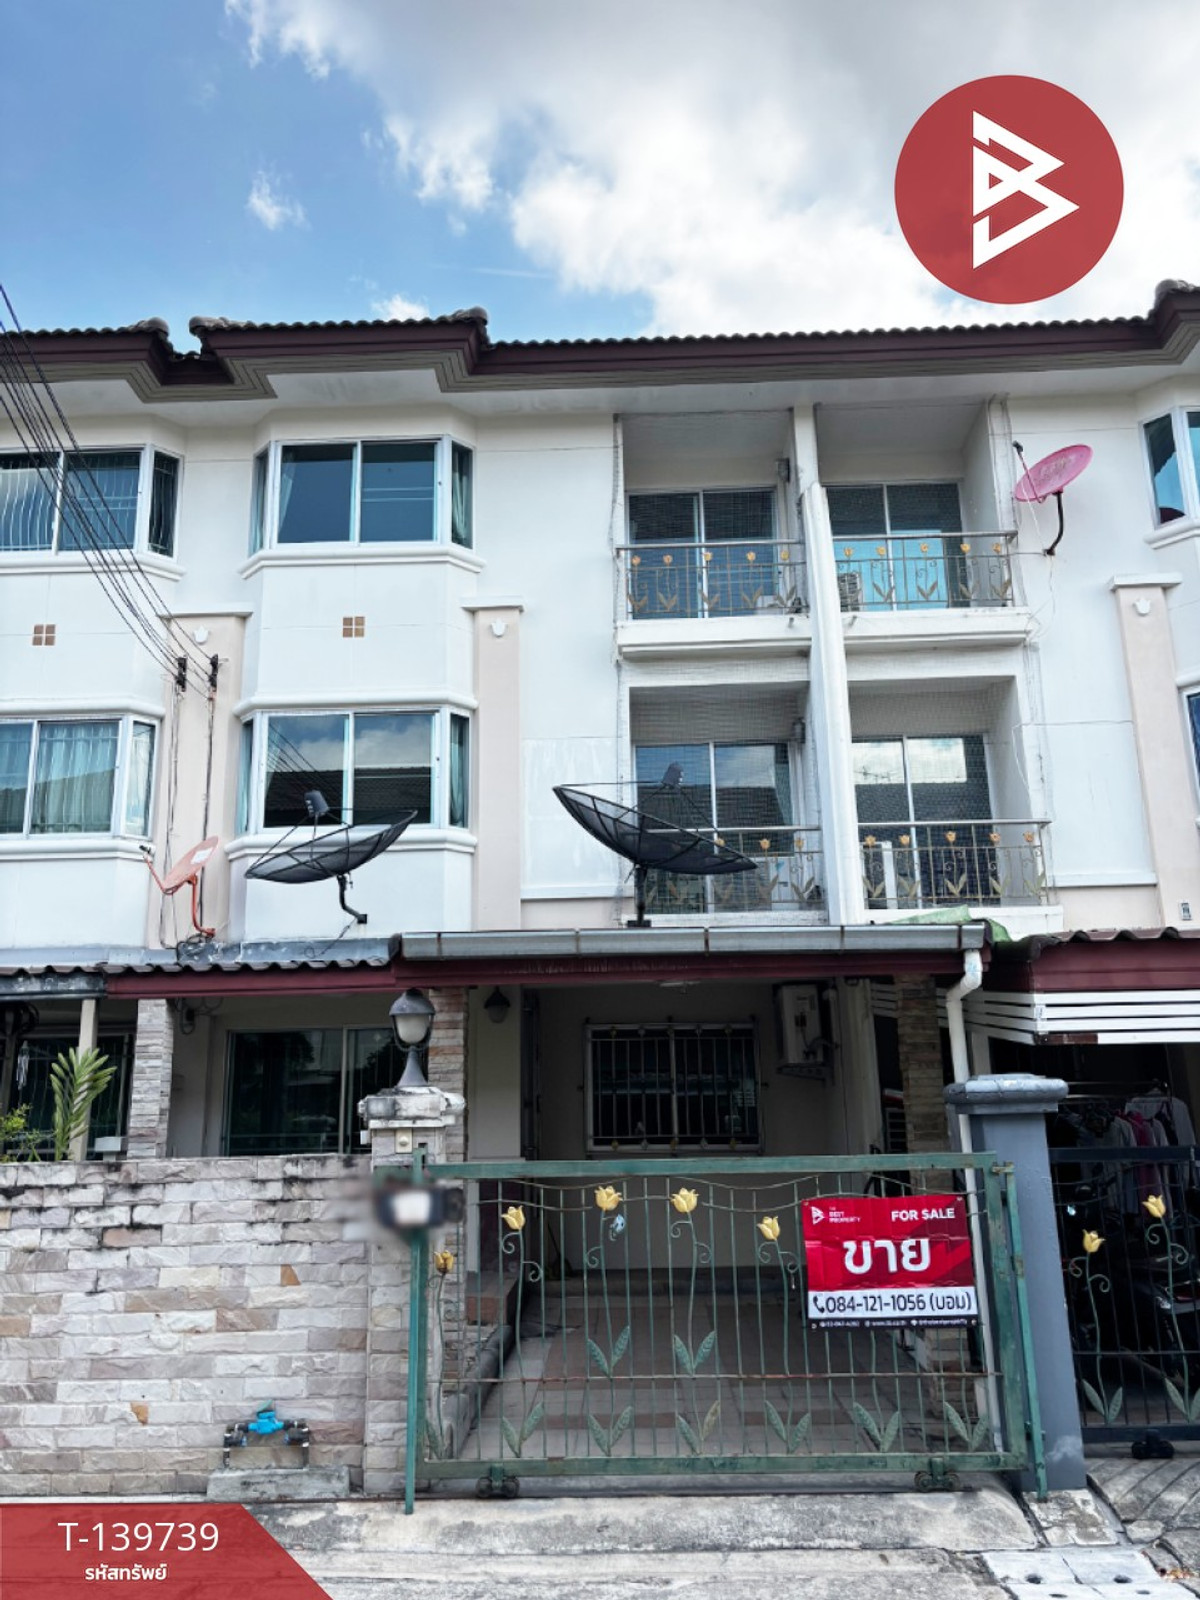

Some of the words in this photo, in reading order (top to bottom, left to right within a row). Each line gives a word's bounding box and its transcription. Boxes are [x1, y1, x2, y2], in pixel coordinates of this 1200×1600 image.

[891, 1209, 919, 1222] FOR
[922, 1207, 955, 1221] SALE
[843, 1238, 932, 1275] ขาย
[825, 1294, 926, 1314] 084-121-1056
[930, 1291, 972, 1312] (บอม)
